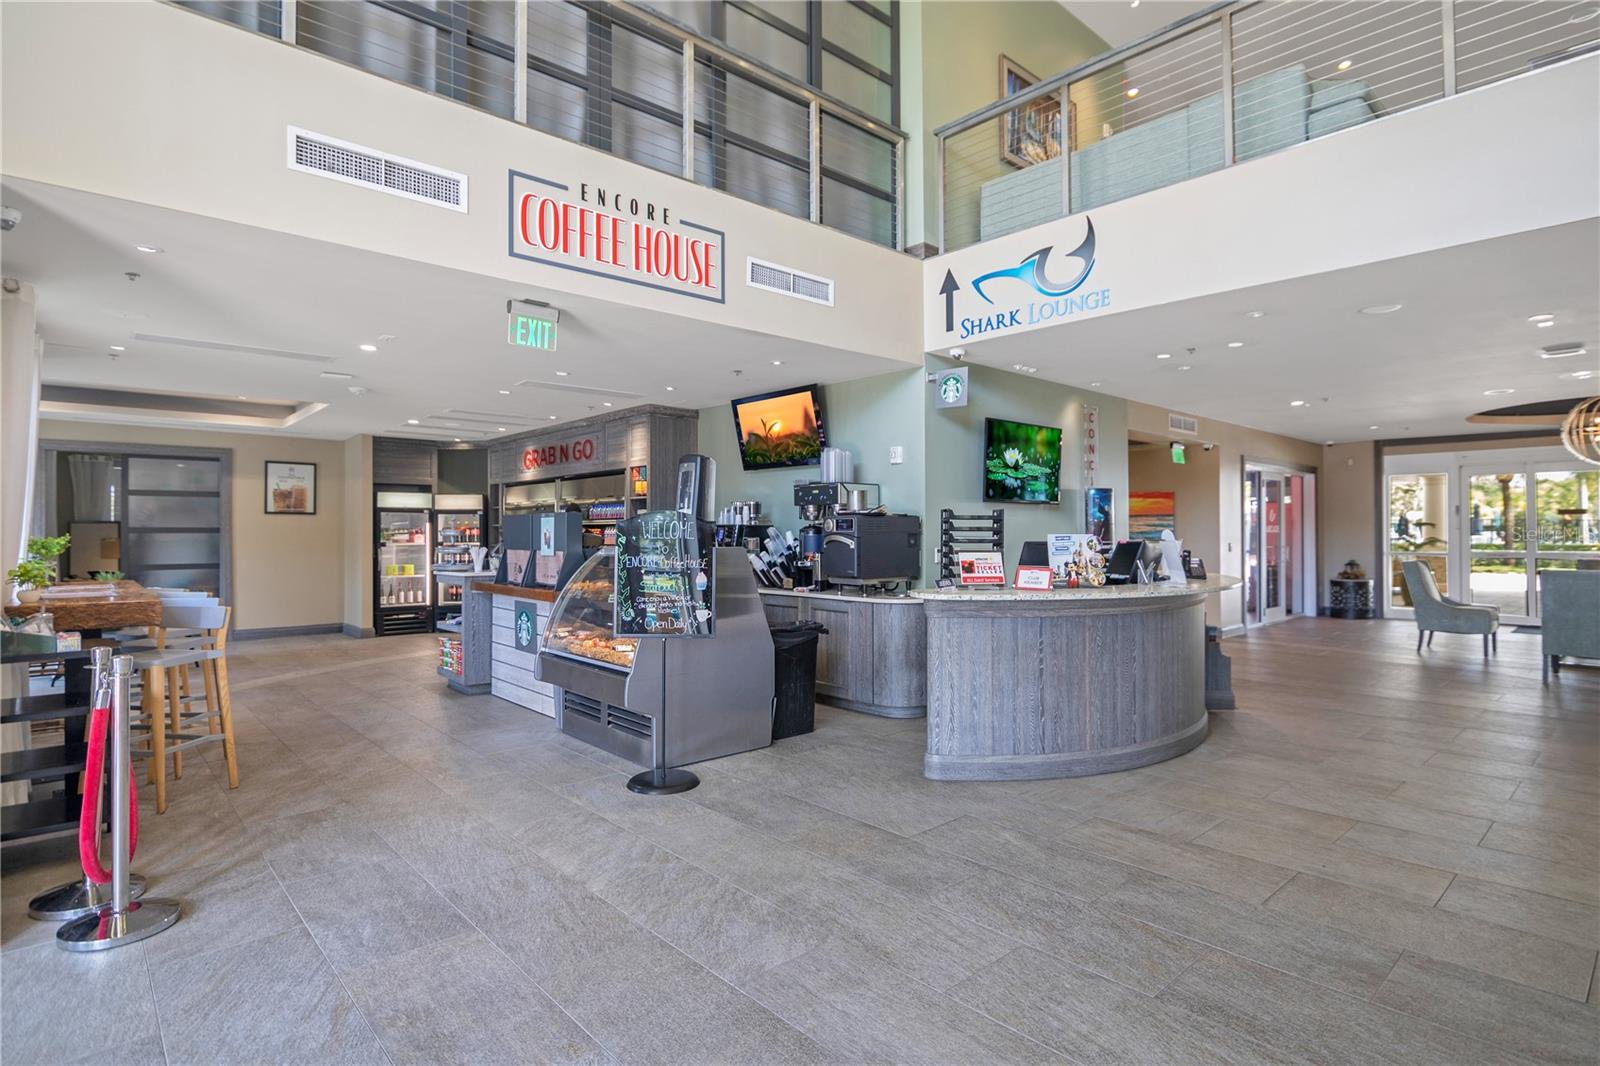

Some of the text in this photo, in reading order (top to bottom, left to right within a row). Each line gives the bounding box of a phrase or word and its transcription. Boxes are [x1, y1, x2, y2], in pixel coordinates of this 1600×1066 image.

[581, 183, 670, 225] ENCORE
[519, 192, 718, 289] COFFEE HOUSE
[516, 316, 552, 349] EXIT
[523, 438, 593, 470] GRAB N GO
[642, 520, 695, 540] WELCOME
[644, 617, 688, 635] Open Daily
